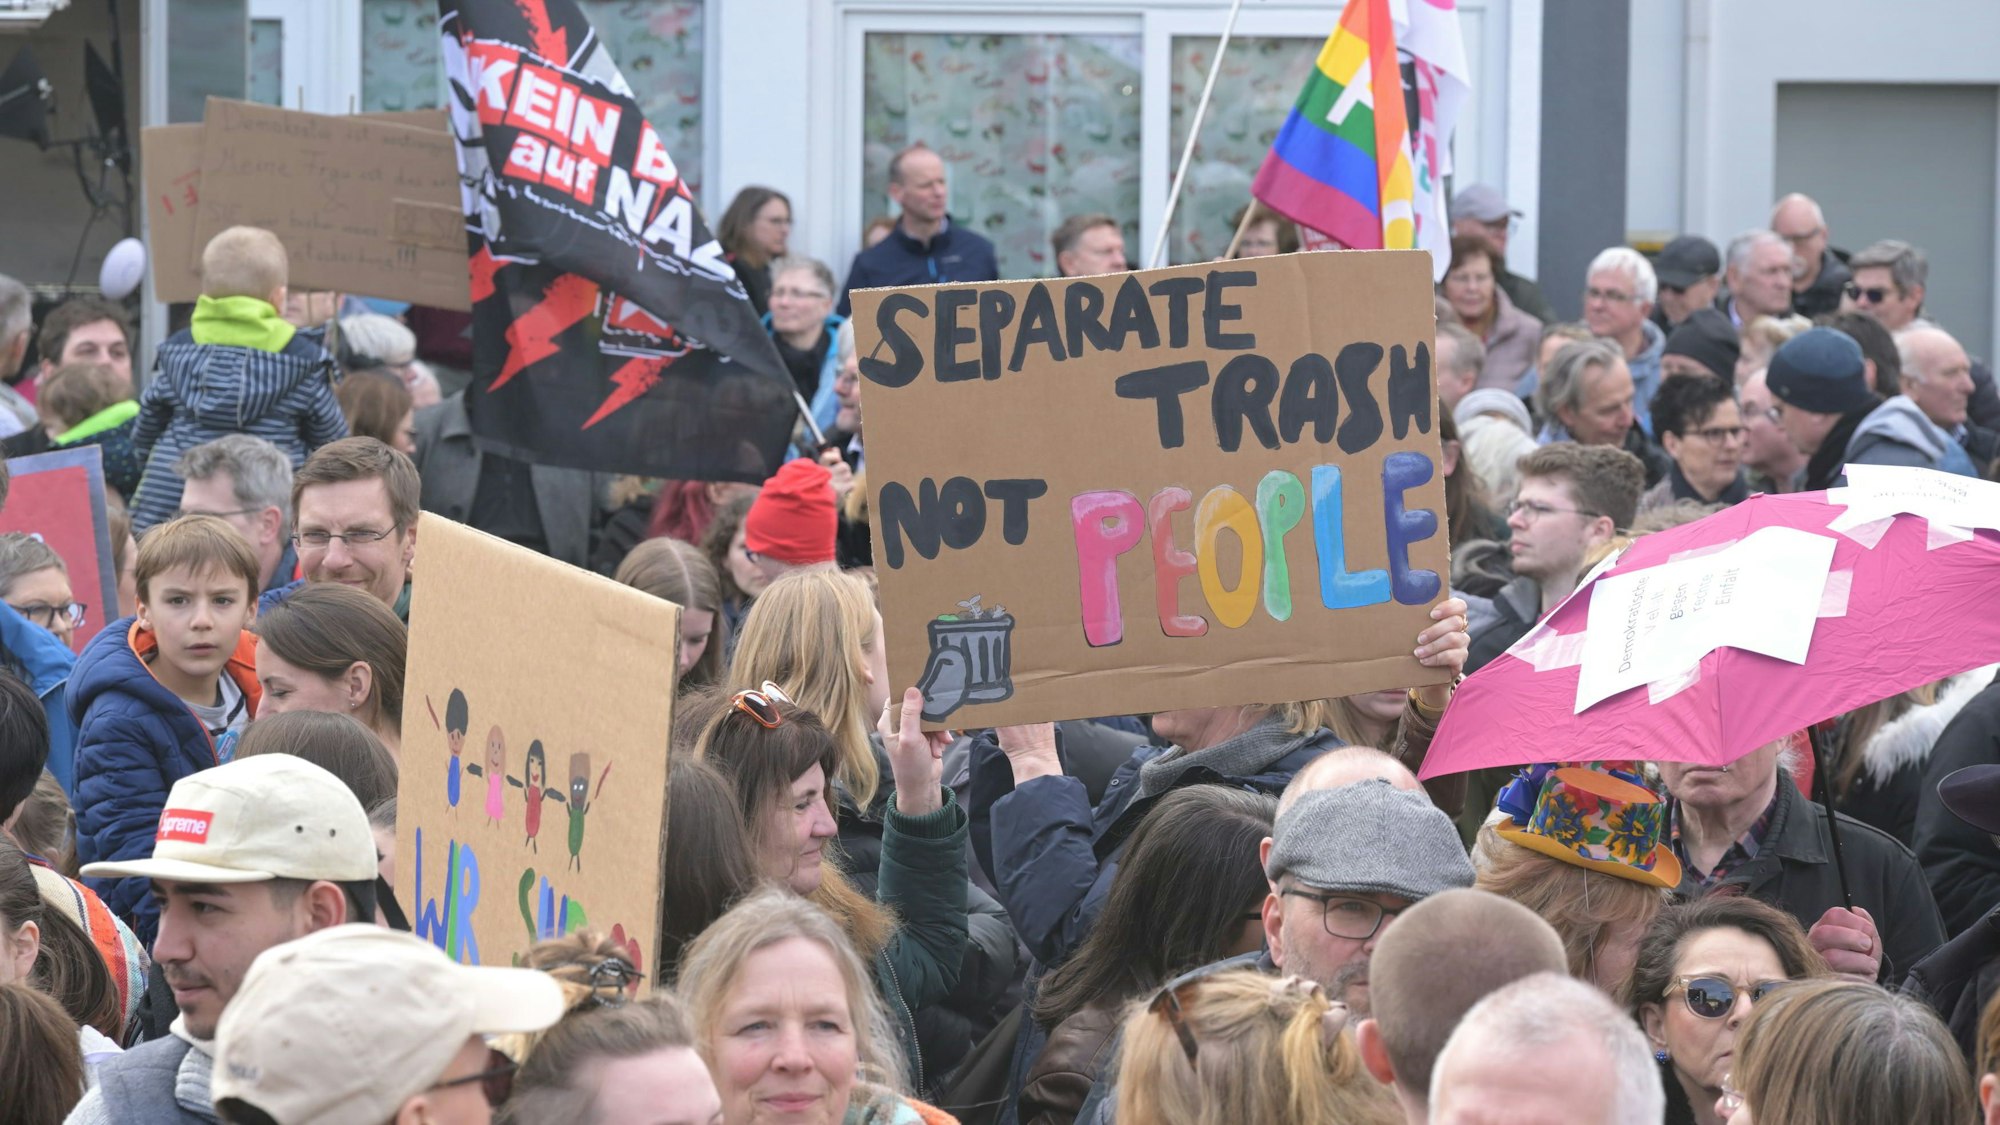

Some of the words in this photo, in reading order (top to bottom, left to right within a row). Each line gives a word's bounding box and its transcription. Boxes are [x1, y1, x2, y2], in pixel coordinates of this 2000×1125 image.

[470, 56, 622, 158] KEIN
[508, 135, 598, 194] auf
[858, 270, 1257, 388] SEPARATE
[1115, 341, 1432, 455] TRASH
[878, 476, 1048, 570] NOT
[1070, 451, 1443, 648] PEOPLE
[1692, 574, 1714, 612] rechte
[1715, 568, 1740, 606] Einfalt
[1618, 576, 1650, 674] Demokratische
[1669, 583, 1689, 621] gegen
[415, 825, 482, 967] WIR
